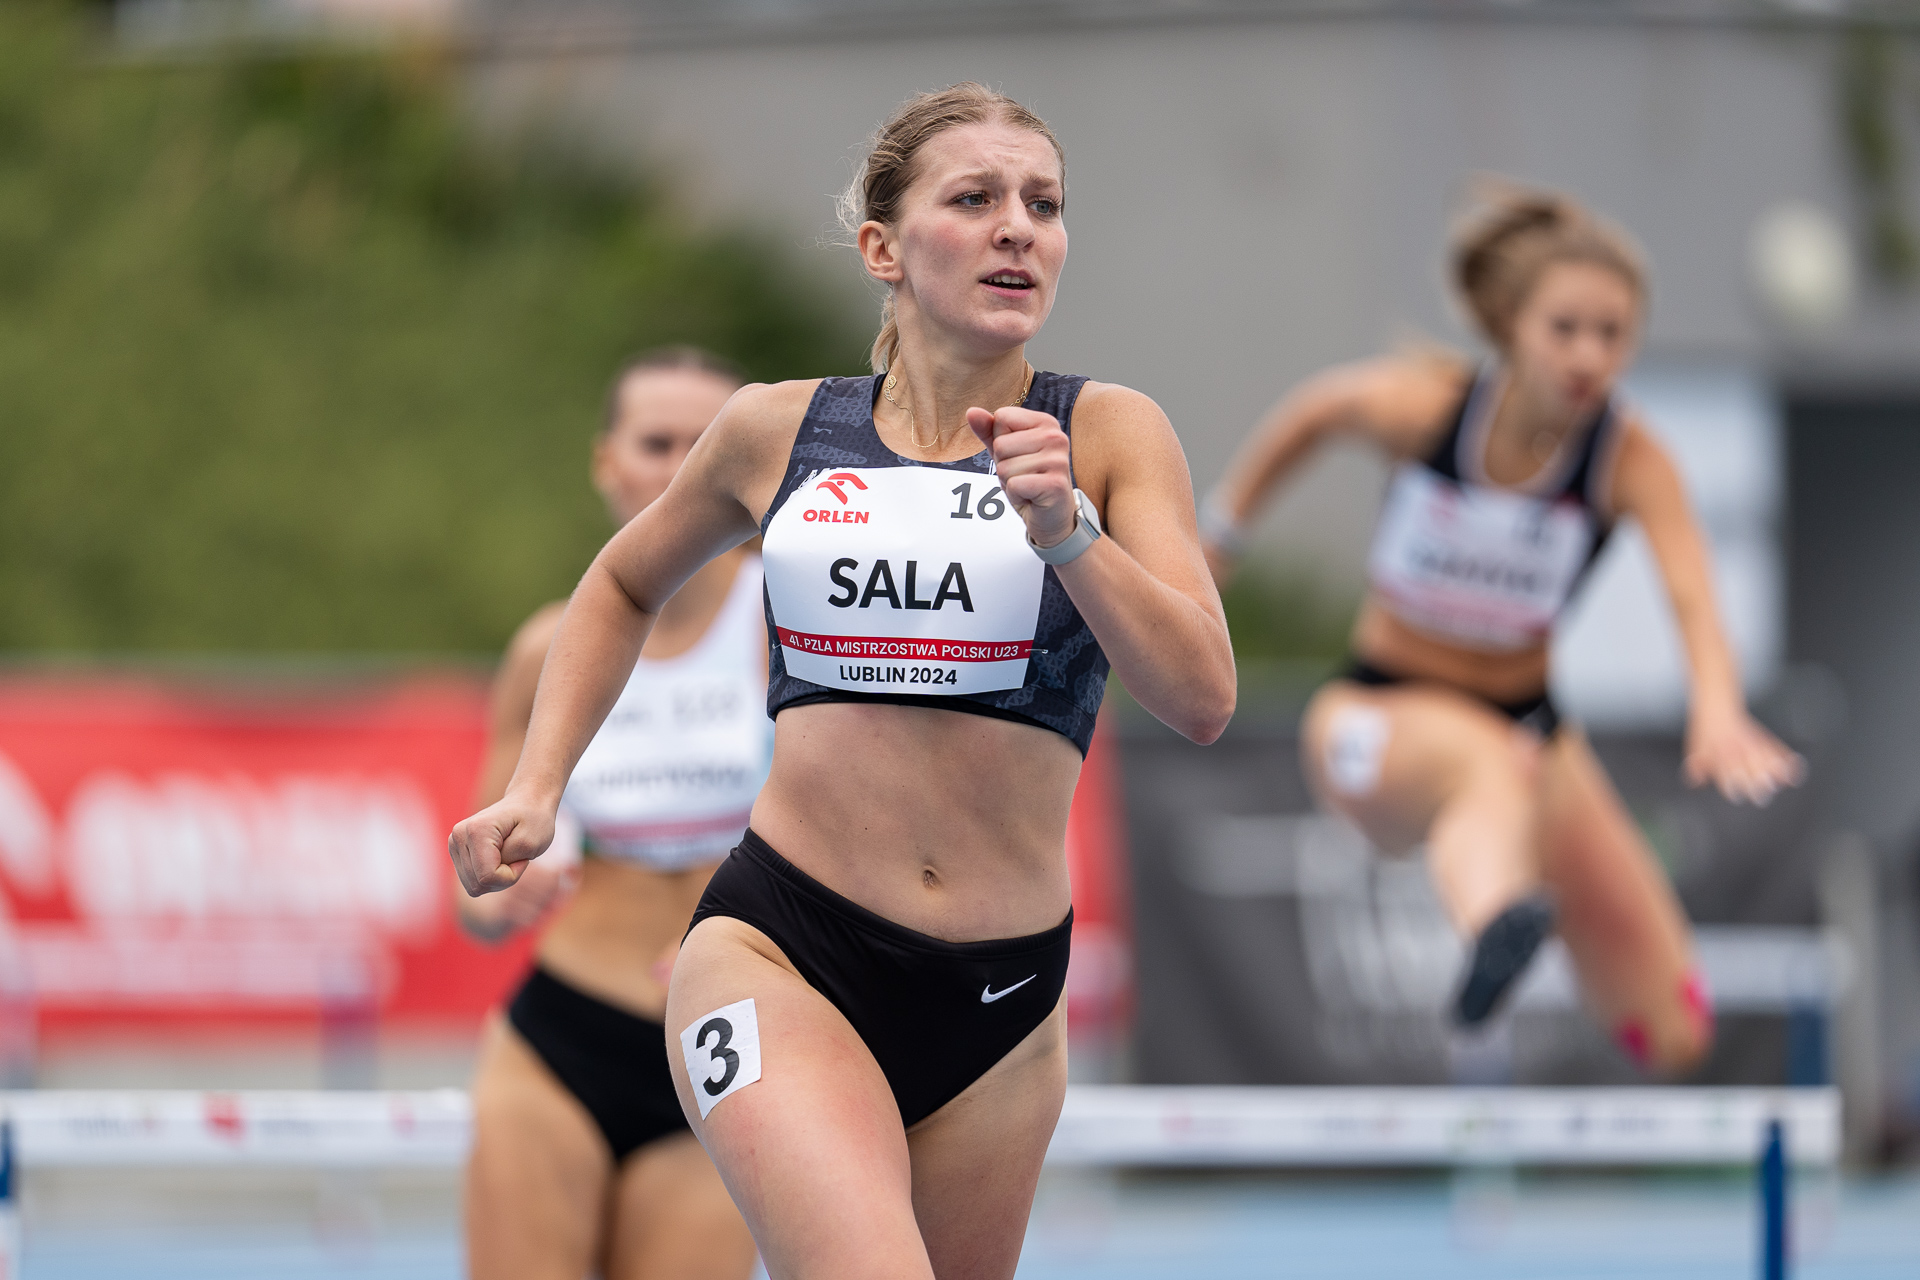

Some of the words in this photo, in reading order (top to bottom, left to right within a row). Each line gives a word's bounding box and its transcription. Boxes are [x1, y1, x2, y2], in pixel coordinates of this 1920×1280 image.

[803, 509, 870, 524] ORLEN
[950, 482, 1005, 521] 16
[827, 557, 974, 612] SALA
[789, 634, 803, 648] 41.
[804, 638, 833, 652] PZLA
[836, 641, 938, 657] MISTRZOSTWA
[941, 644, 991, 659] POLSKI
[994, 645, 1019, 658] U23
[839, 665, 906, 683] LUBLIN
[909, 667, 957, 685] 2024
[696, 1017, 740, 1096] 3
